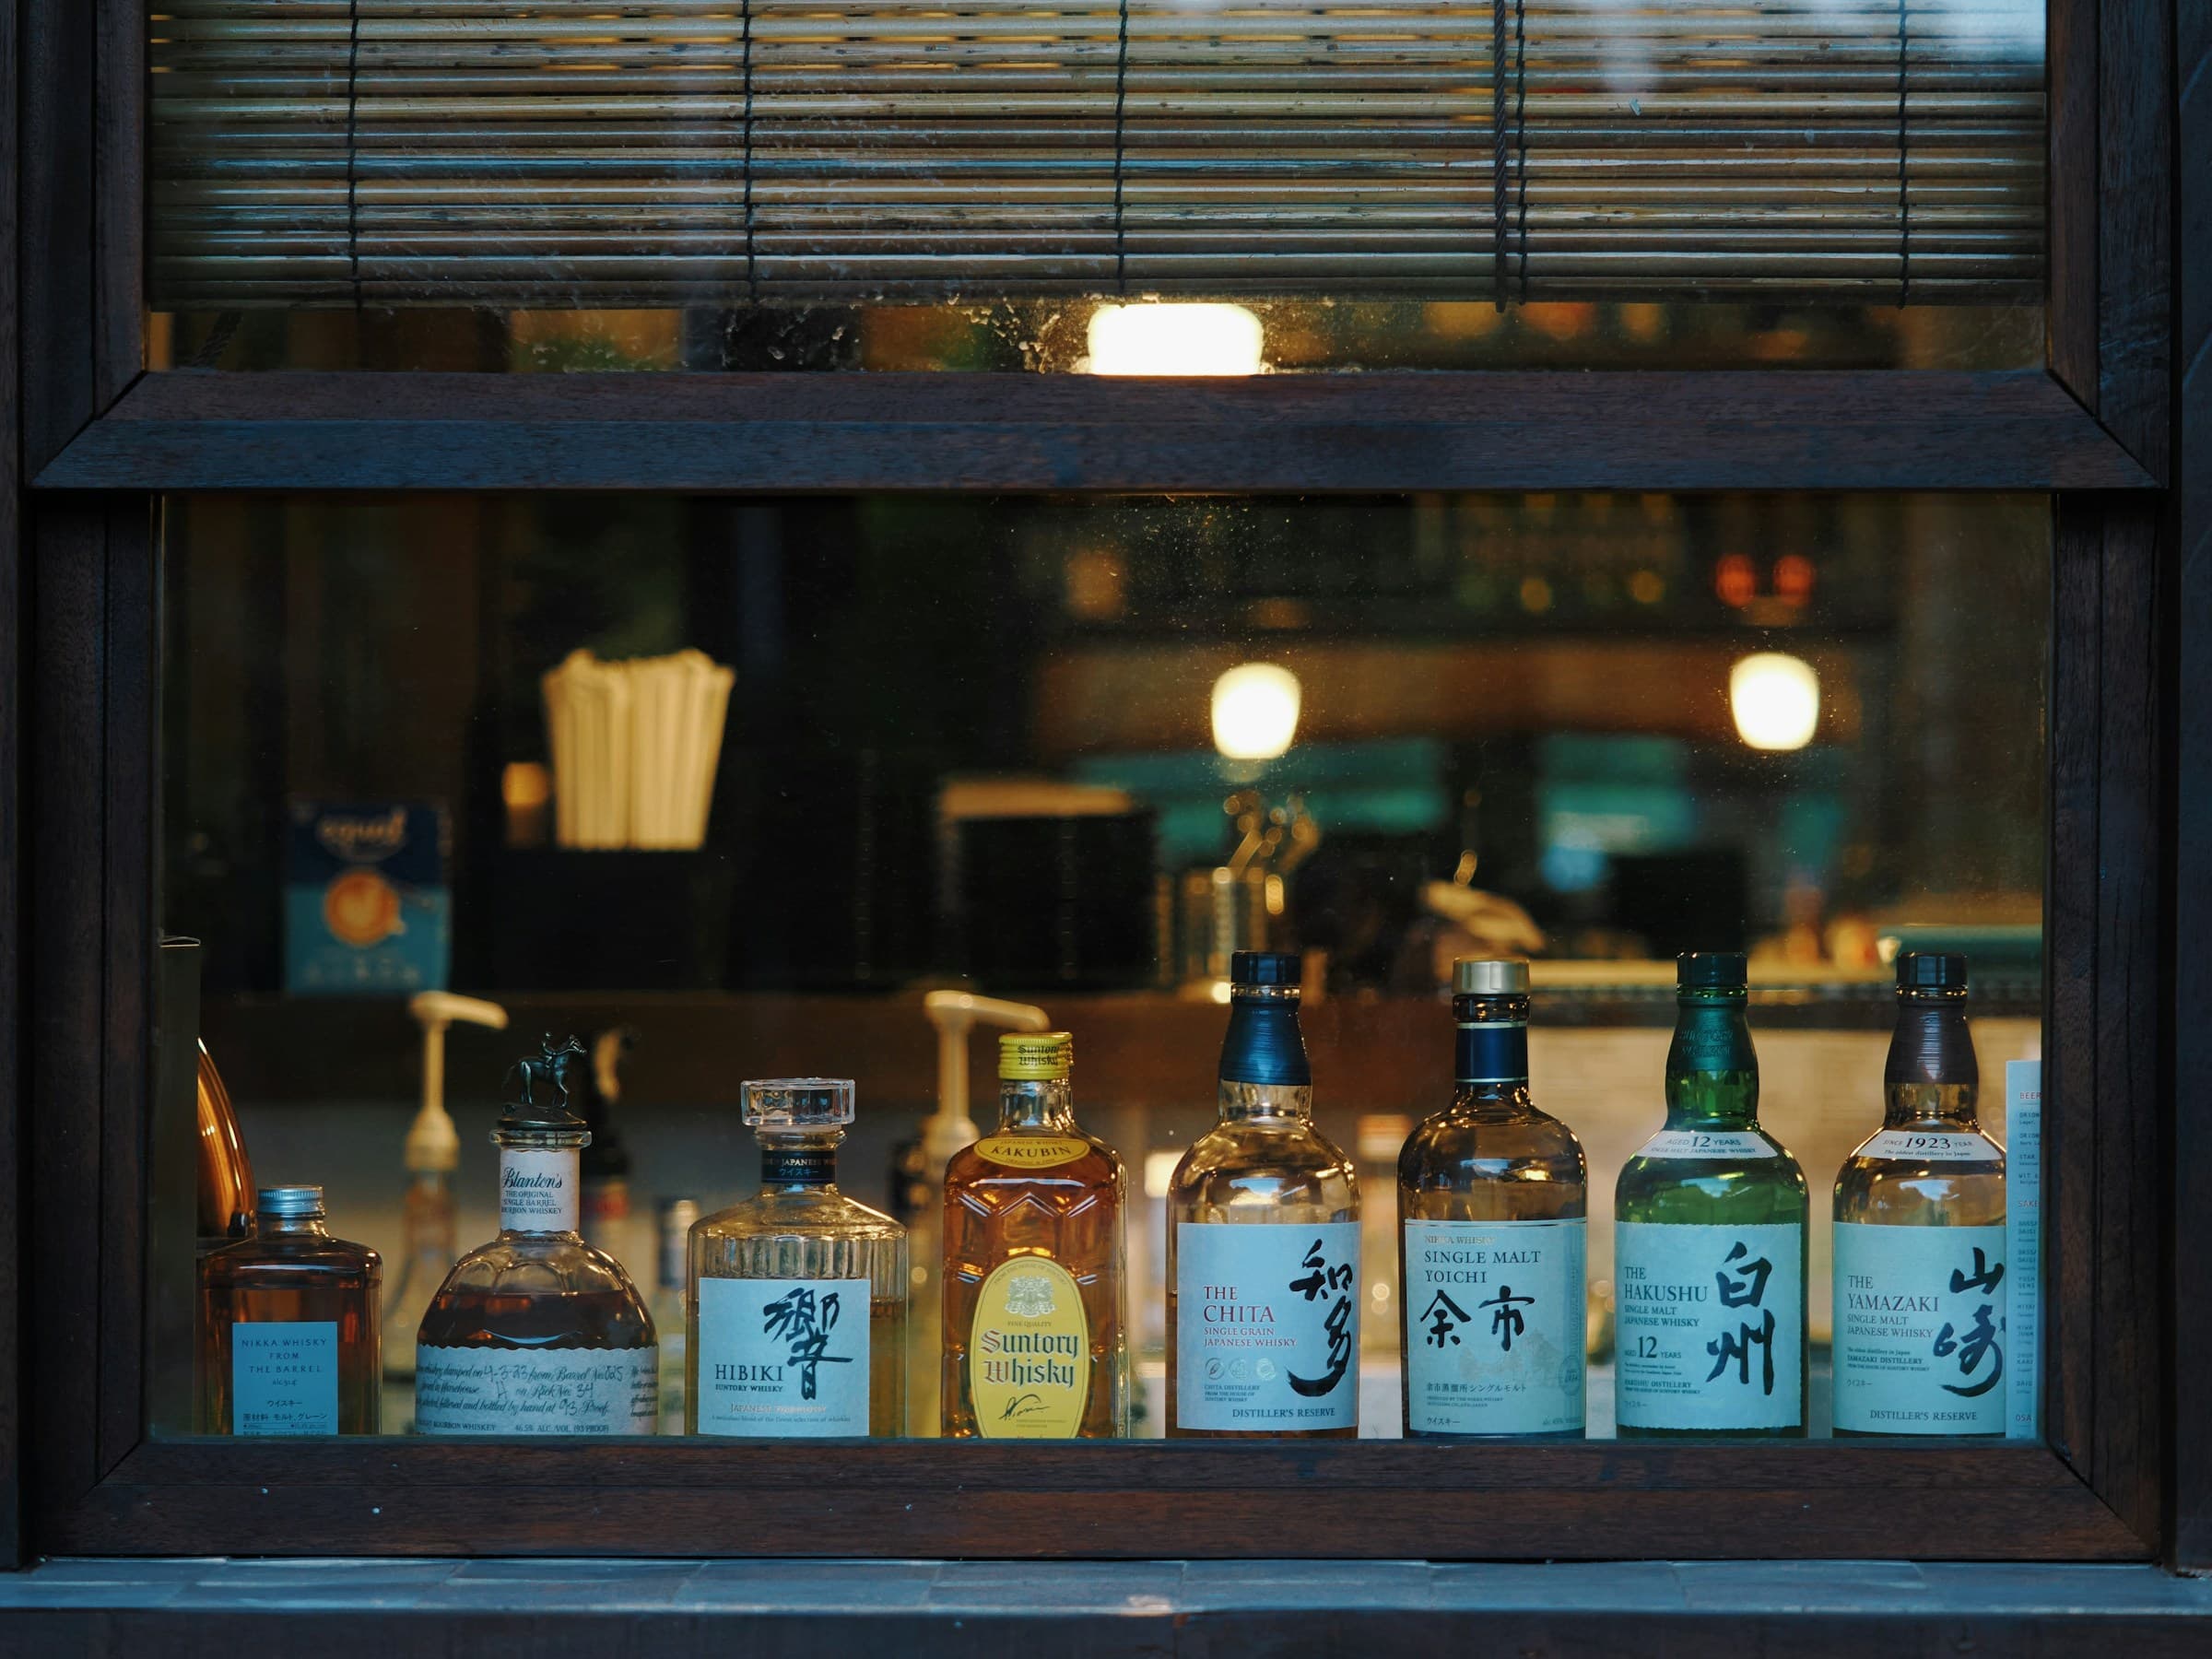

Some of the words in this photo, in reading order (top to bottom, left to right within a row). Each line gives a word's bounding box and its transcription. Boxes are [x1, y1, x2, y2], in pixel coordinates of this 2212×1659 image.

[1692, 1136, 1712, 1147] 12
[1906, 1137, 1951, 1149] 1923
[992, 1146, 1071, 1159] KAKUBIN
[502, 1167, 562, 1188] Blanton's
[1424, 1235, 1454, 1243] NIKA
[1424, 1251, 1487, 1264] SINGLE
[1493, 1251, 1541, 1264] MALT
[1425, 1270, 1487, 1283] YOICHI
[1625, 1266, 1646, 1279] THE
[1848, 1276, 1874, 1289] THE
[1204, 1286, 1238, 1300] THE
[1625, 1284, 1708, 1302] HAKUSHU
[1848, 1293, 1939, 1312] YAMAZAKI
[1204, 1305, 1276, 1323] CHITA
[1651, 1306, 1677, 1315] MALT
[1420, 1285, 1535, 1351] 余市
[1624, 1317, 1659, 1326] JAPANESE
[1661, 1318, 1700, 1327] WHISKY
[1705, 1241, 1776, 1396] 白州
[1848, 1314, 1877, 1324] SINGLE
[1880, 1315, 1909, 1325] MALT
[1205, 1327, 1238, 1335] SINGLE
[1241, 1327, 1275, 1335] GRAIN
[1847, 1326, 1888, 1336] JAPANESE
[1891, 1328, 1934, 1337] WHISKY
[241, 1338, 277, 1347] NIKKA
[282, 1338, 326, 1347] WHISKY
[981, 1330, 1078, 1359] Suntory
[1204, 1338, 1252, 1347] JAPANESE
[1255, 1338, 1297, 1347] WHISKY
[1638, 1335, 1658, 1359] 12
[269, 1352, 300, 1360] FROM
[1880, 1357, 1923, 1365] DISTILLERY
[249, 1365, 270, 1373] THE
[276, 1365, 323, 1373] BARREL
[714, 1364, 783, 1382] HIBIKI
[982, 1359, 1074, 1388] Whisky
[1232, 1408, 1294, 1418] DISTILLER'S
[1297, 1407, 1335, 1418] RESERVE
[1870, 1410, 1929, 1420] DISTILLER'S
[1933, 1411, 1977, 1420] RESERVE
[462, 1422, 496, 1430] WHISKEY
